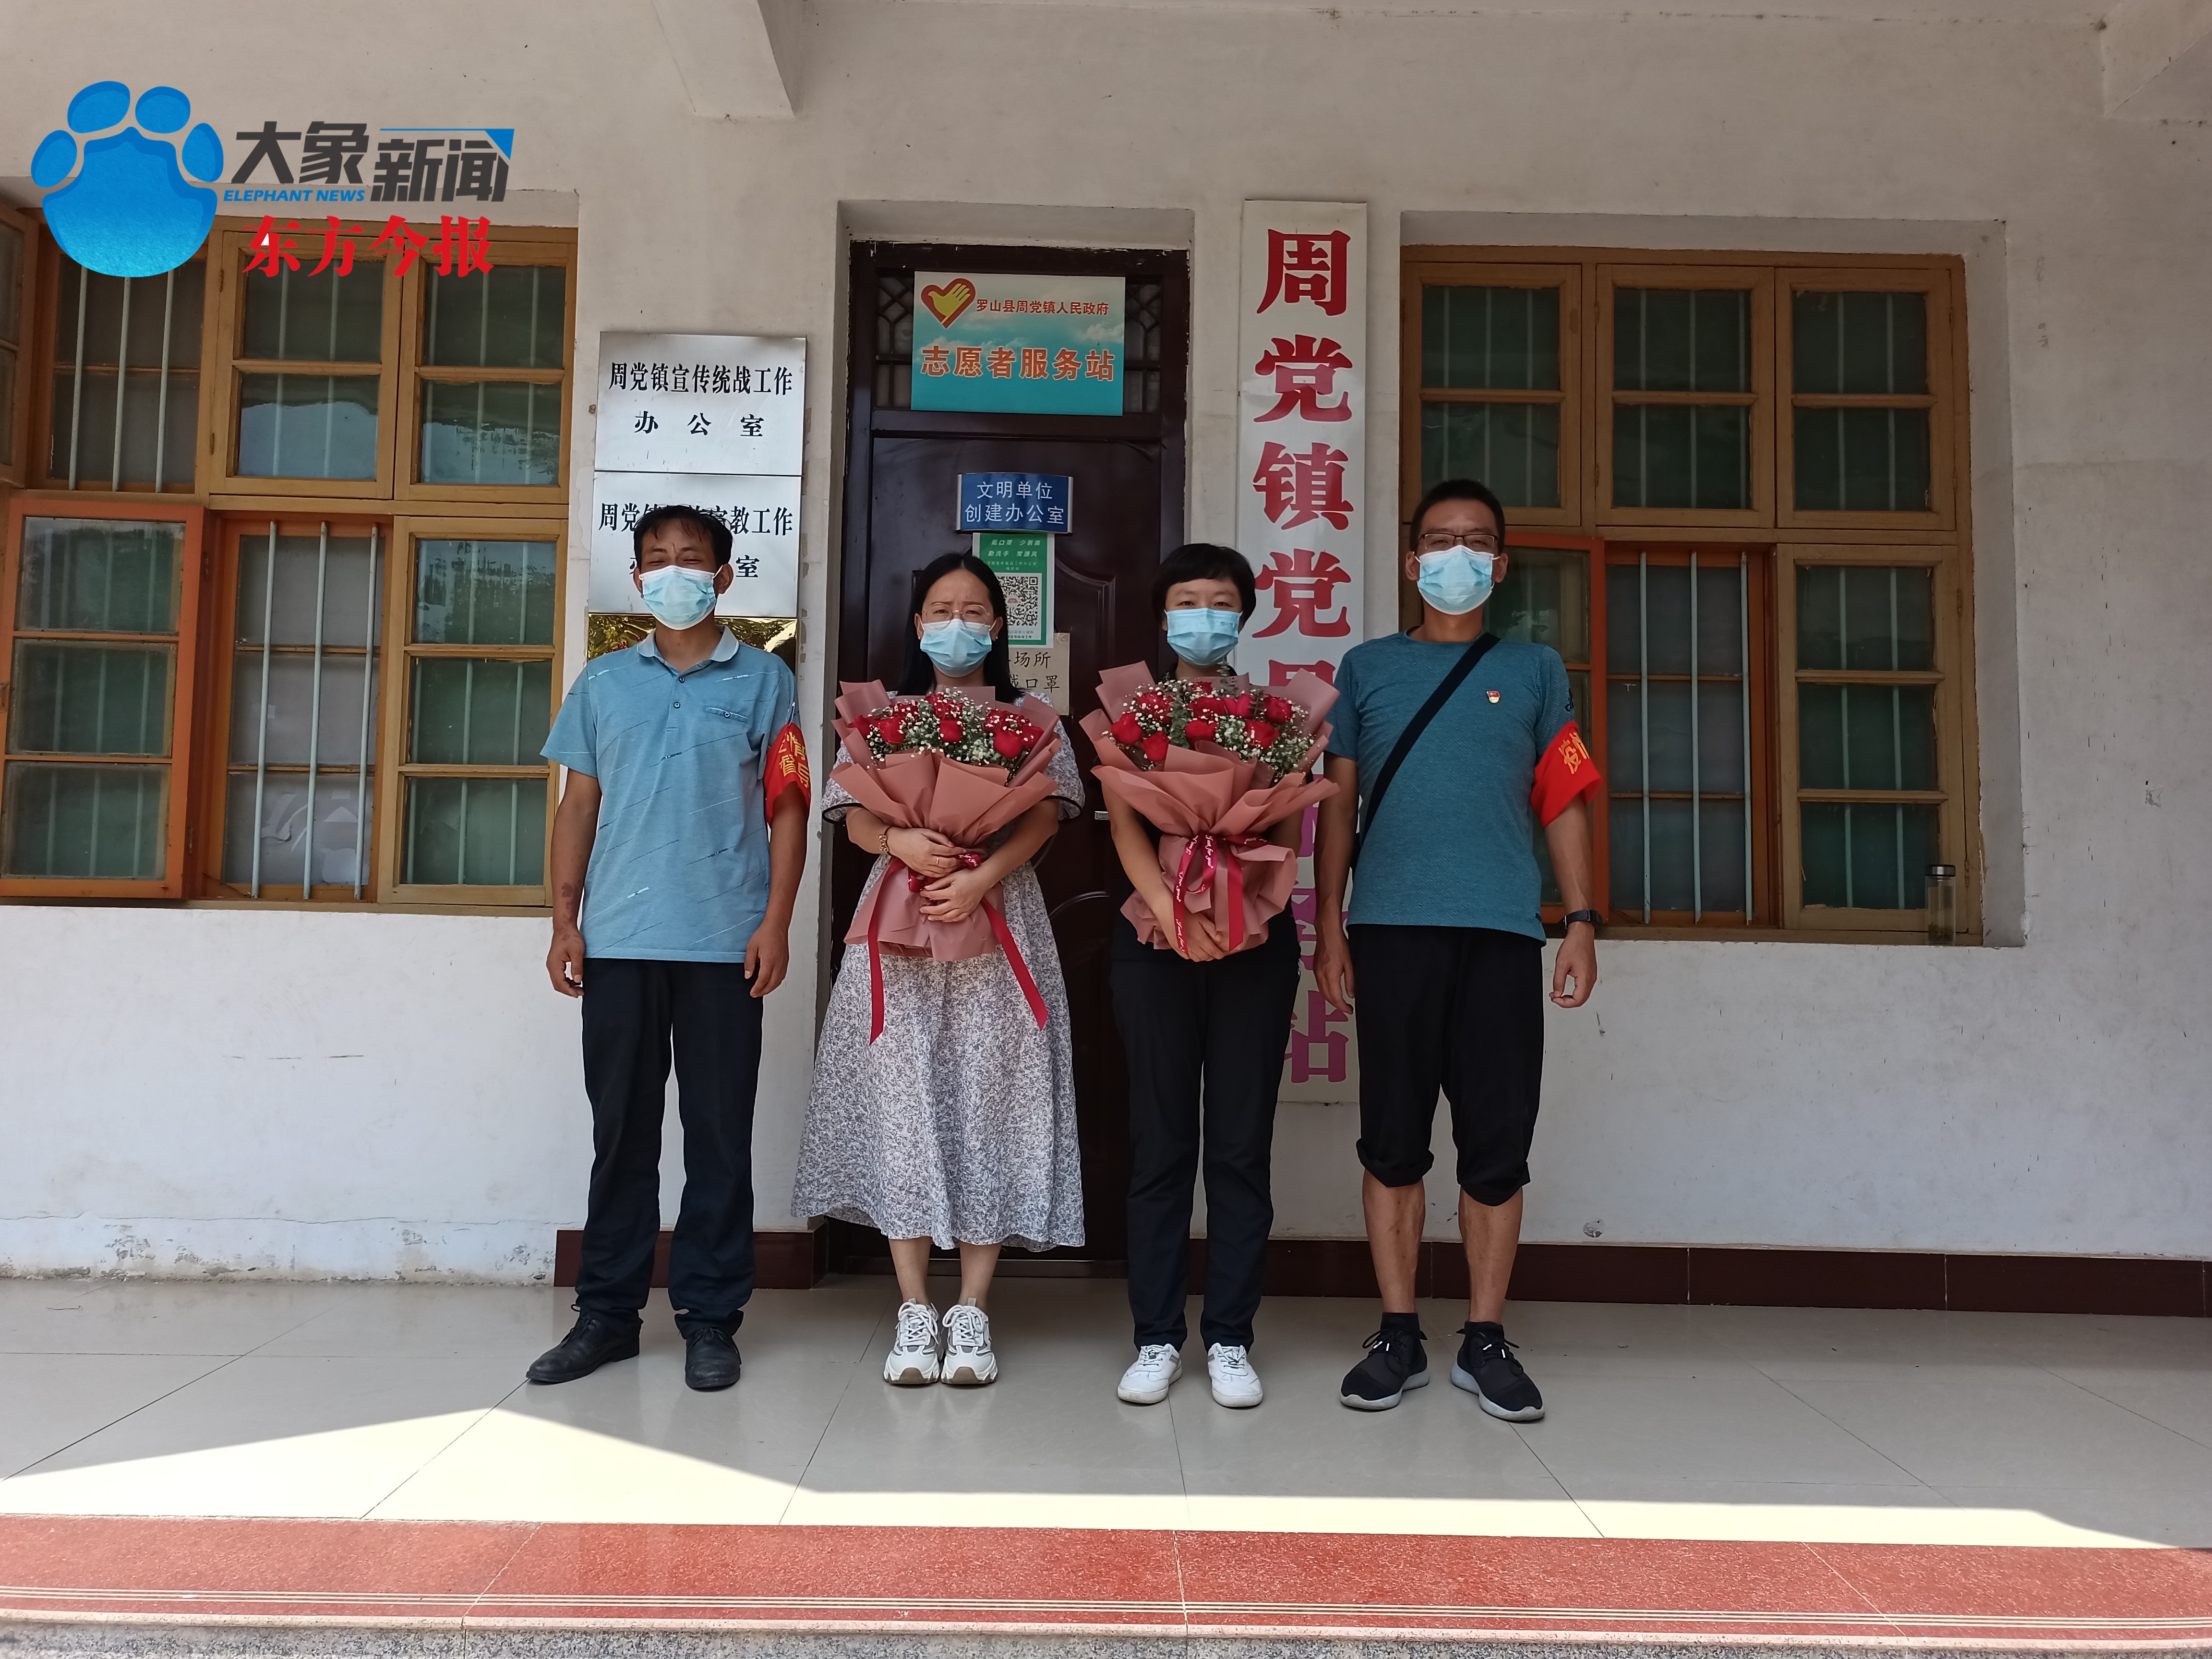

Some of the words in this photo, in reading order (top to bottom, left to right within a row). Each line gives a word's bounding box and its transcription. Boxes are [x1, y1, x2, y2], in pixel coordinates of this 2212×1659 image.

[976, 299, 1109, 315] 罗山县周党镇人民政府
[921, 345, 1115, 382] 志愿者服务站
[608, 361, 793, 396] 周党镇宣传统战工作
[976, 481, 1053, 500] 文明单位
[965, 504, 1065, 525] 创建办公室
[1009, 651, 1051, 669] 场所
